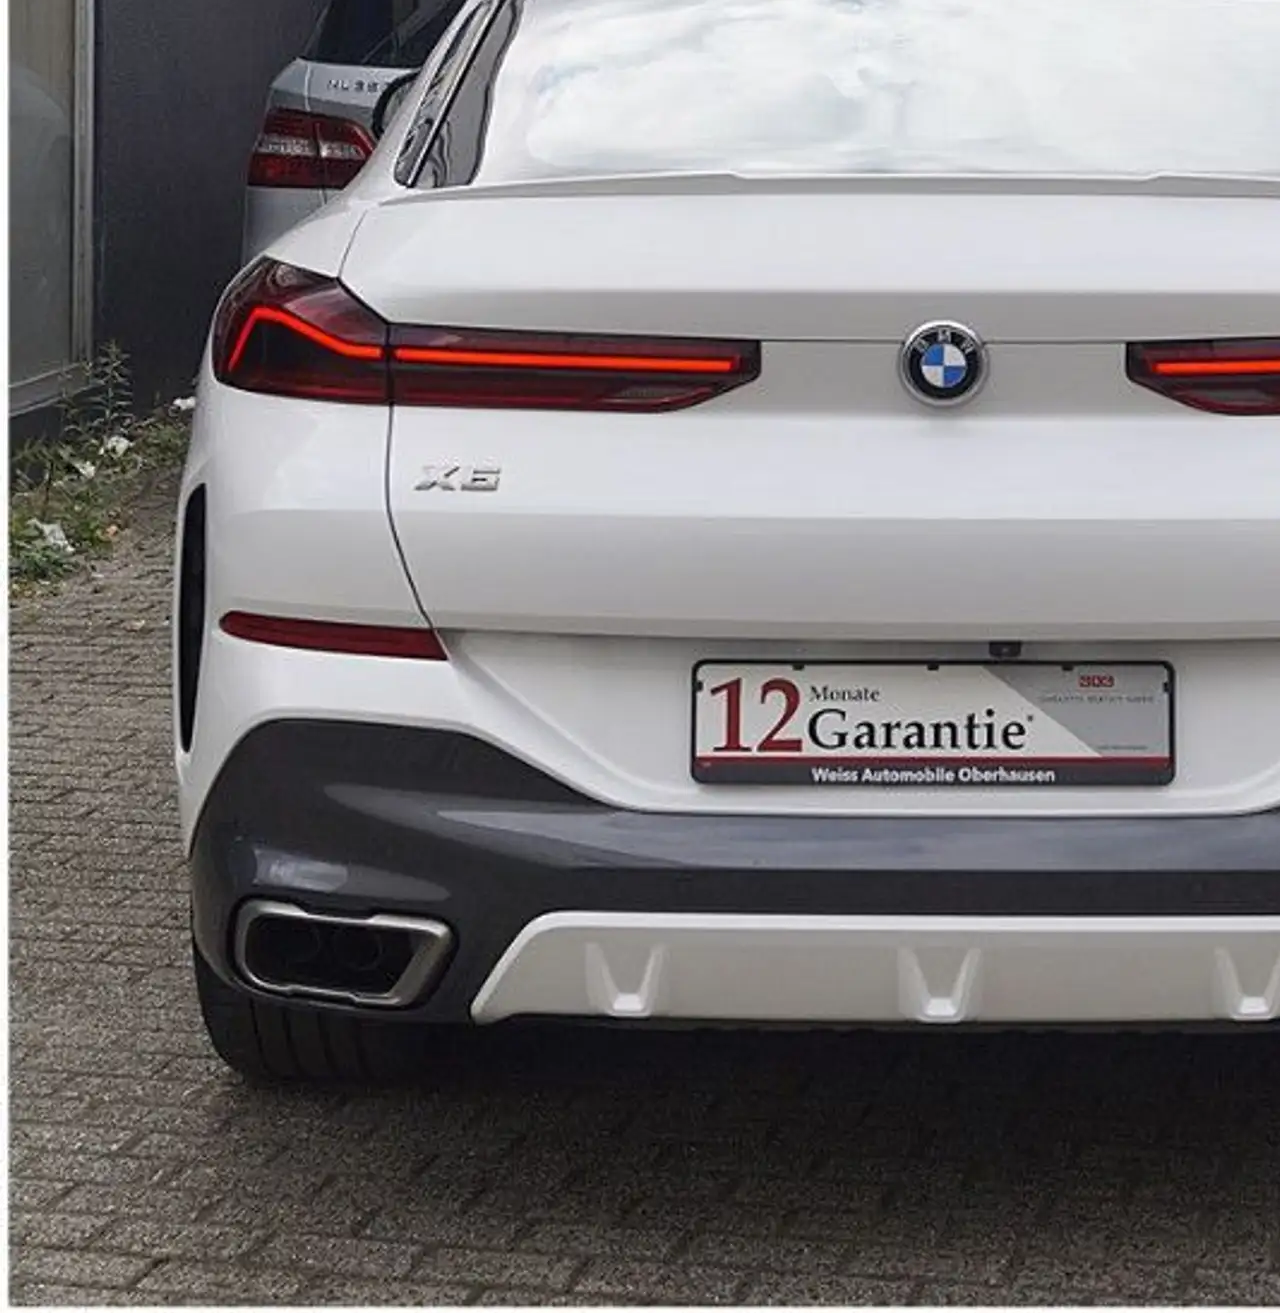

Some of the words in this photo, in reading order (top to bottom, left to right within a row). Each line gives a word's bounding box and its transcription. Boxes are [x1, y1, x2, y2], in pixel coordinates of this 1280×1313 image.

[413, 466, 502, 492] X6
[809, 685, 881, 702] Monate
[709, 677, 803, 753] 12
[811, 767, 859, 782] Weiss
[861, 767, 954, 782] Automobile
[957, 767, 1056, 782] Oberhausen
